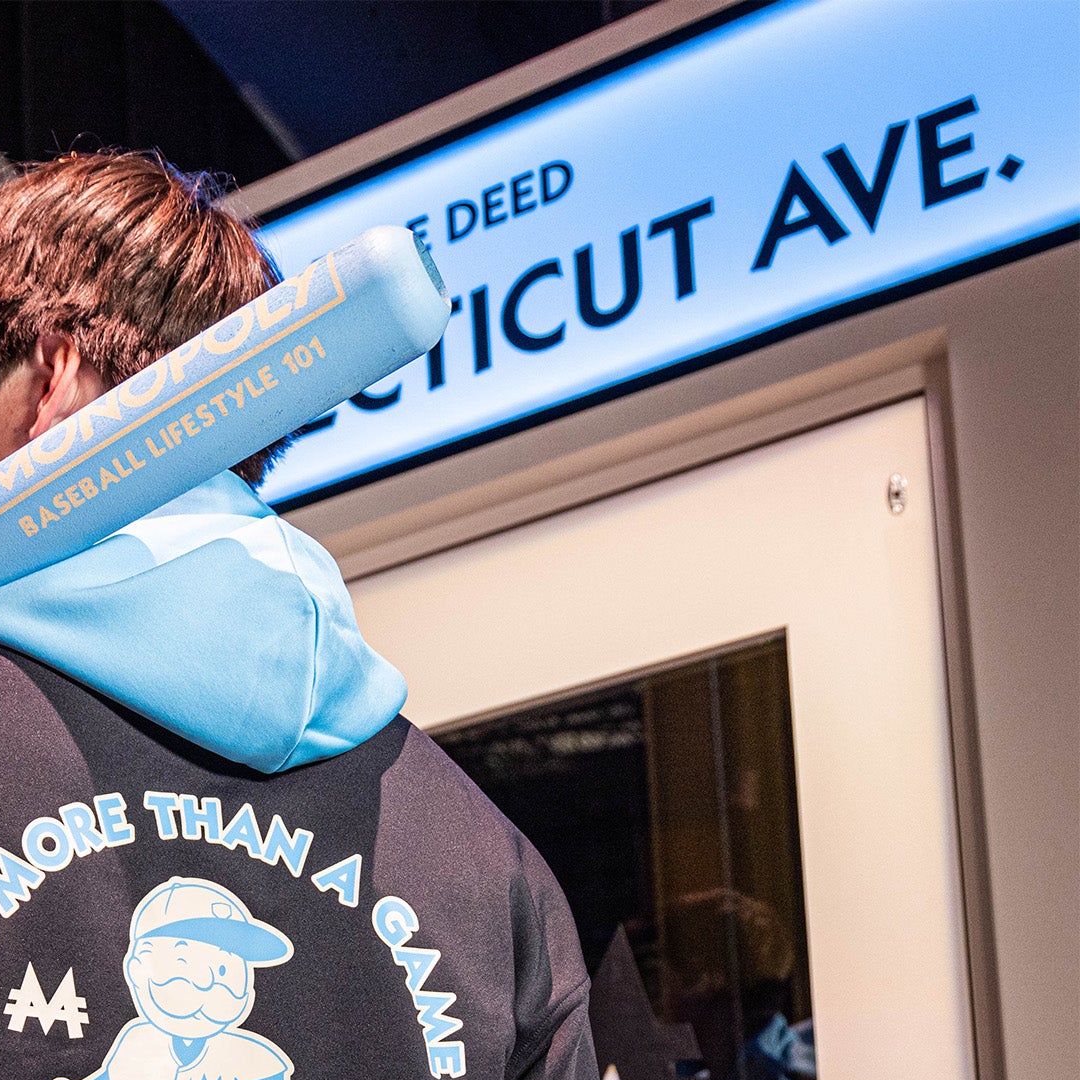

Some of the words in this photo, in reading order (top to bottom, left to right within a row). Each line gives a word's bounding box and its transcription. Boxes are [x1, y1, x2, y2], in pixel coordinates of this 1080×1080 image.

[304, 196, 715, 437] TICUT
[751, 95, 1024, 272] AVE.
[448, 161, 573, 242] DEED
[18, 450, 146, 537] BASEBALL
[145, 365, 279, 458] LIFESTYLE
[281, 336, 327, 376] 101
[143, 790, 314, 877] THAN
[311, 853, 362, 908] A
[371, 895, 466, 1080] GAME
